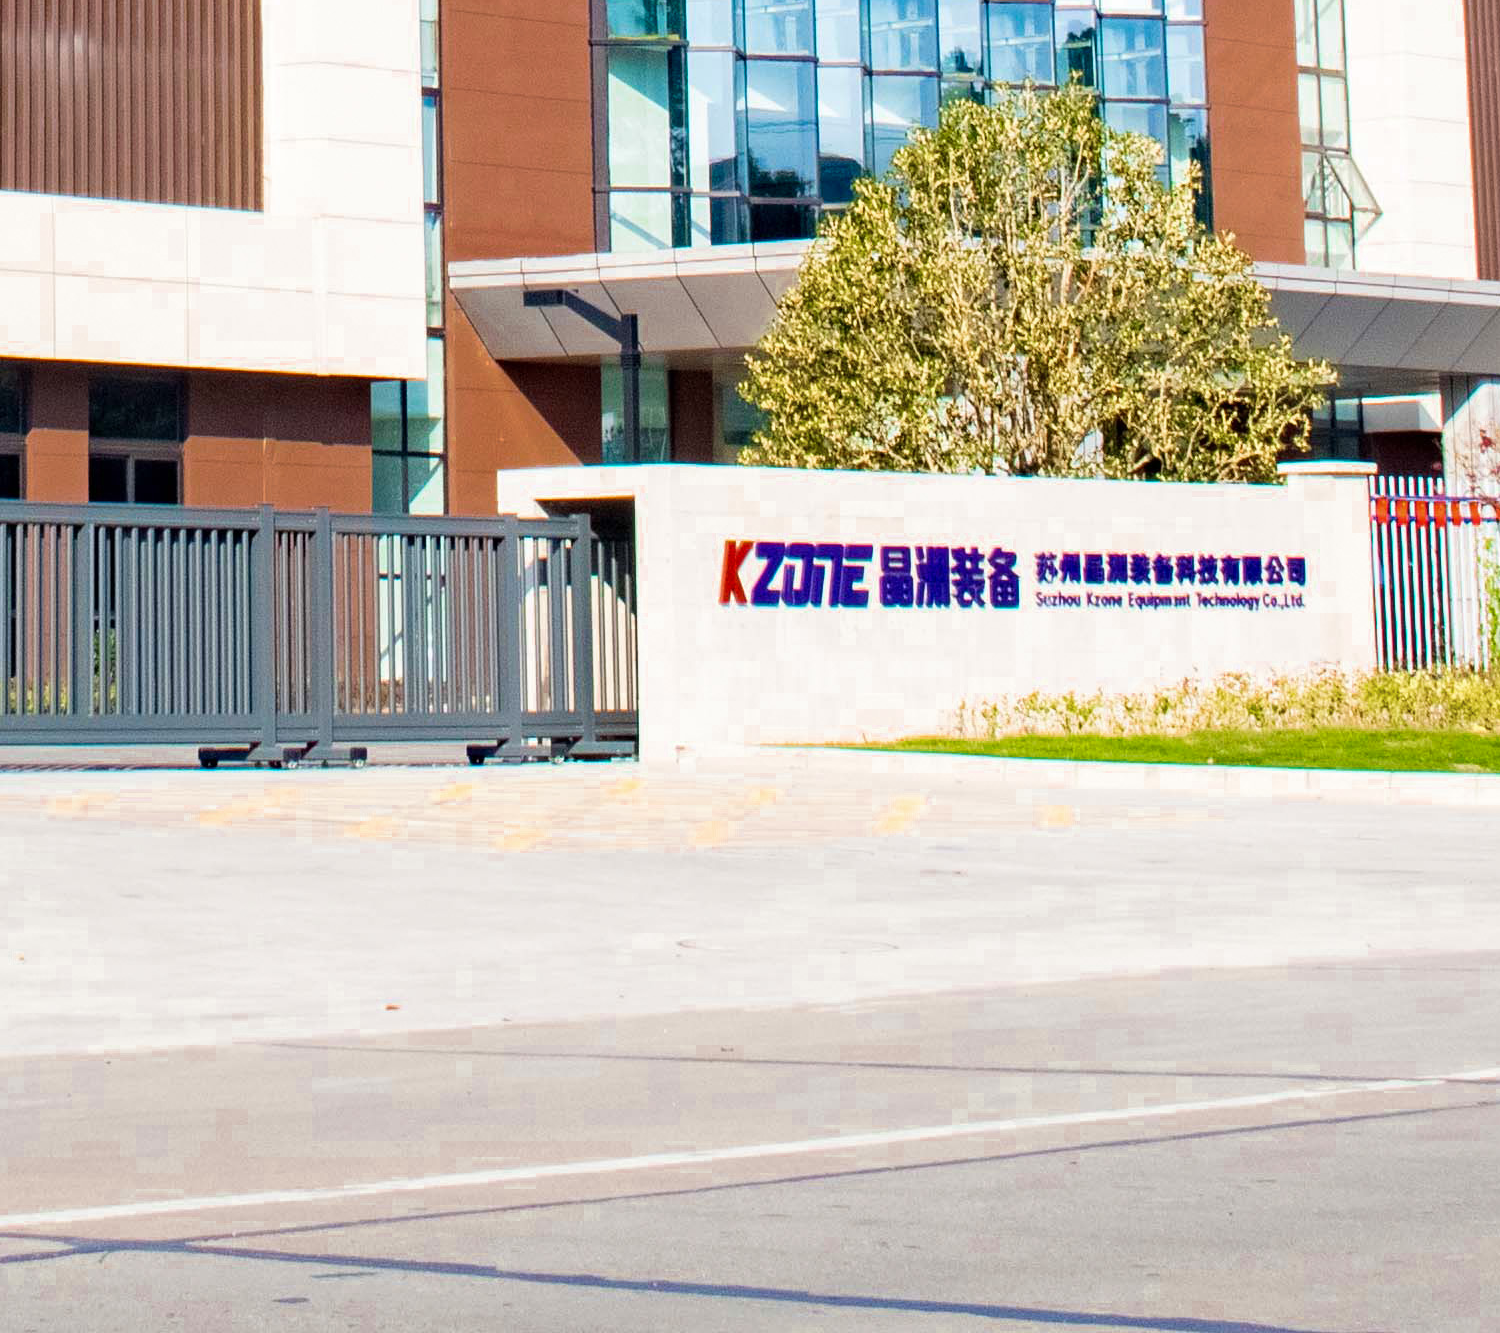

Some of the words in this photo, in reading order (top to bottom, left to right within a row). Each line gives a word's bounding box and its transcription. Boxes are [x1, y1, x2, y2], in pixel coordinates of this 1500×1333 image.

[879, 545, 1020, 609] 晶洲装备
[1034, 552, 1307, 586] 苏州晶洲装备科技有限公司
[1036, 591, 1081, 607] Suzhou
[1086, 591, 1122, 608] Kzone
[1196, 592, 1260, 611] Technology
